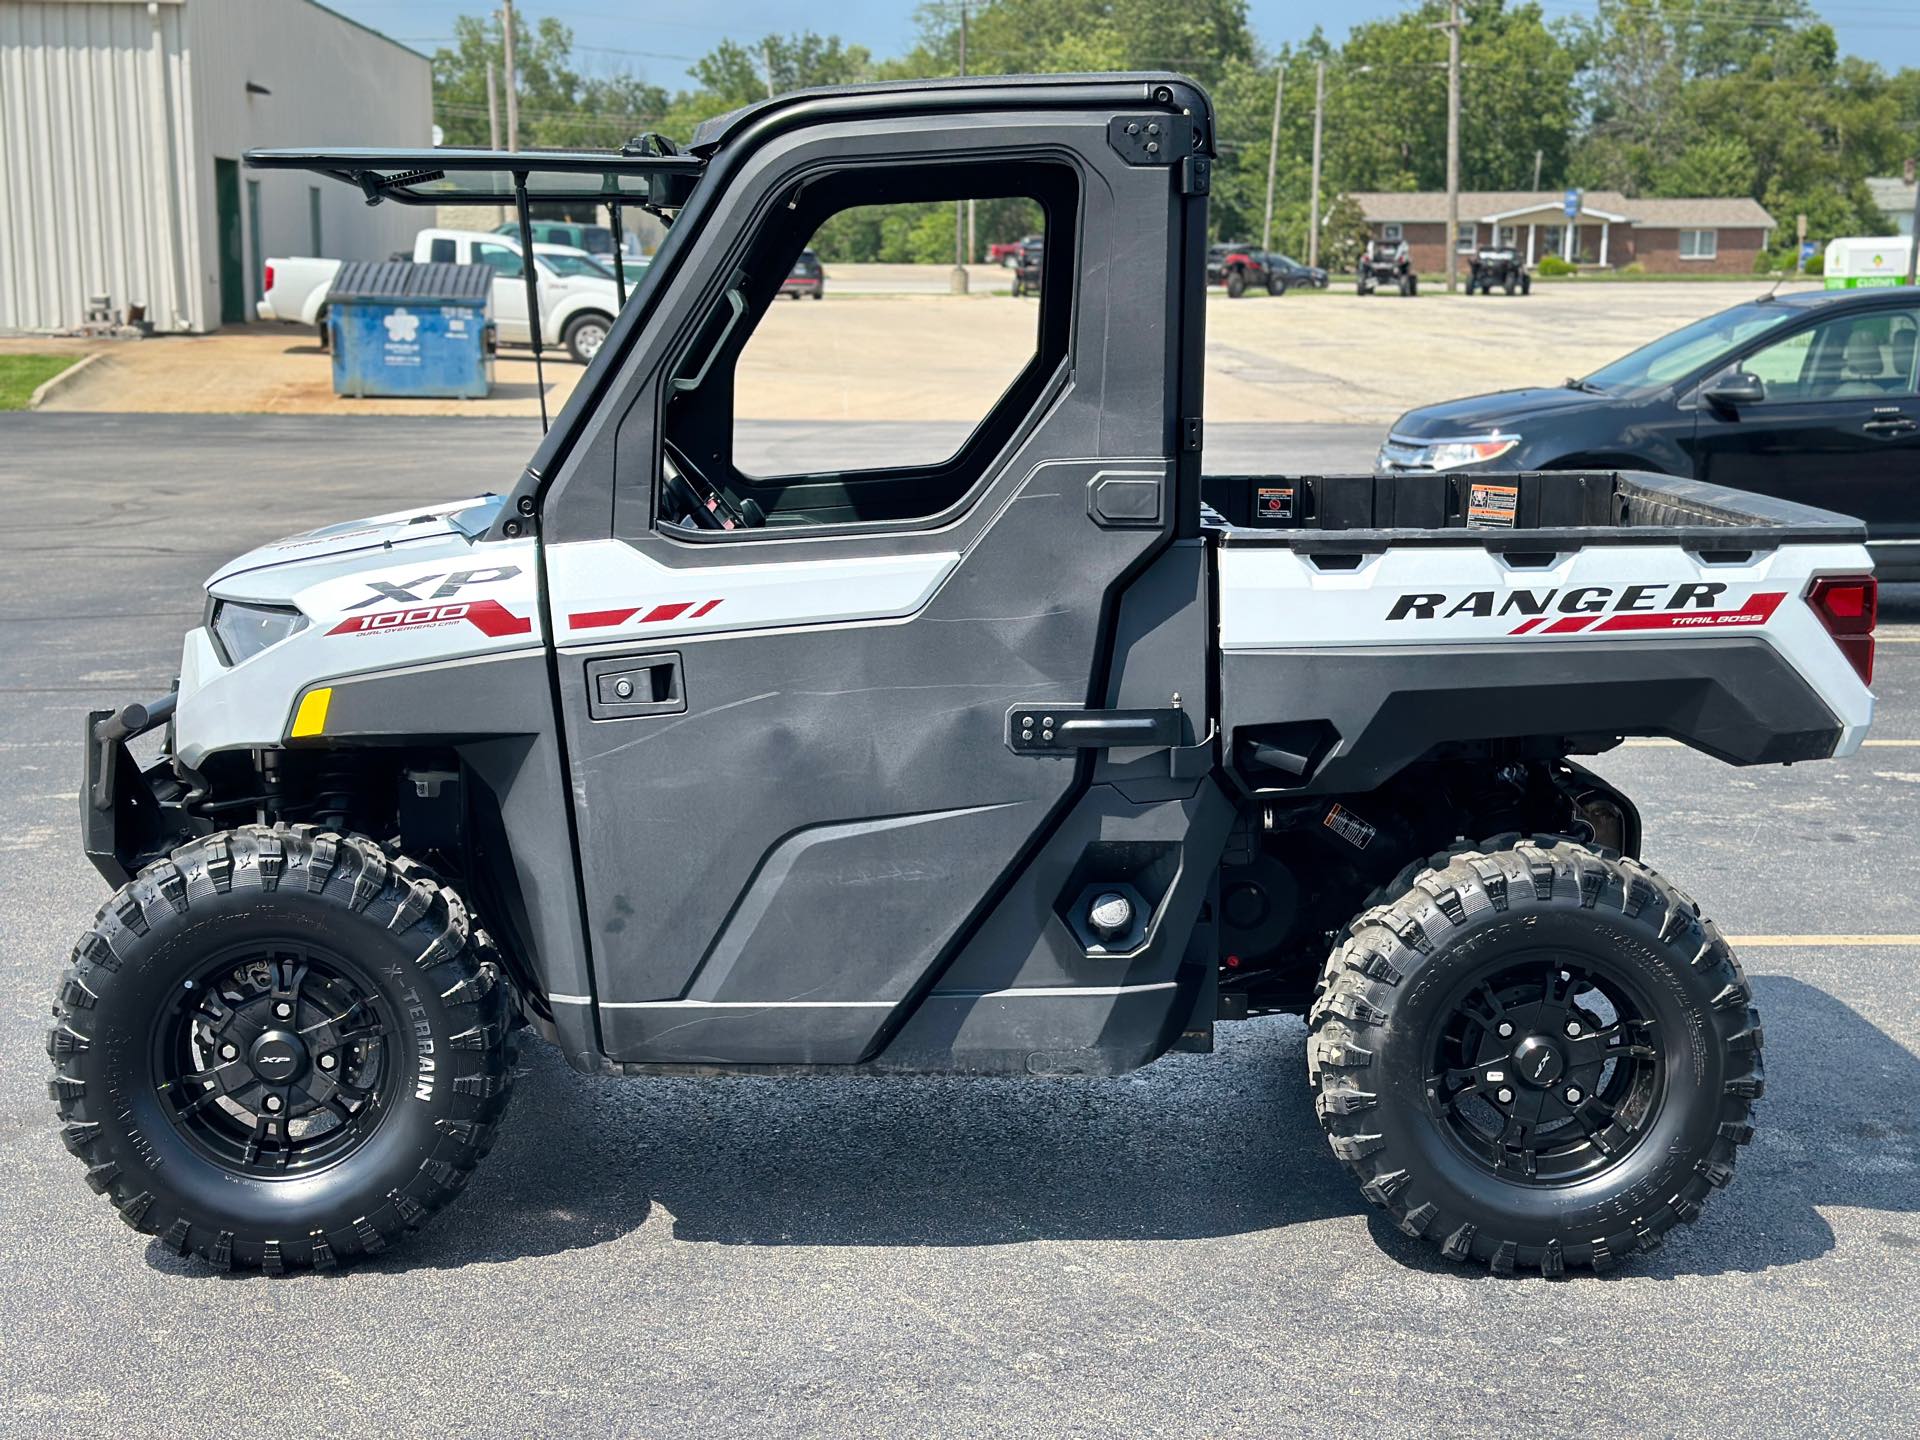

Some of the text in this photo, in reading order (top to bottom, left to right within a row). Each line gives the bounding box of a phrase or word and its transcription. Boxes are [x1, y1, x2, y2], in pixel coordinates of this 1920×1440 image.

[340, 565, 522, 611] XP
[1385, 582, 1728, 621] RANGER
[356, 620, 460, 637] DUAL OVERHEAD CAM
[359, 604, 471, 630] 1000
[1671, 614, 1764, 625] TRAIL BOSS
